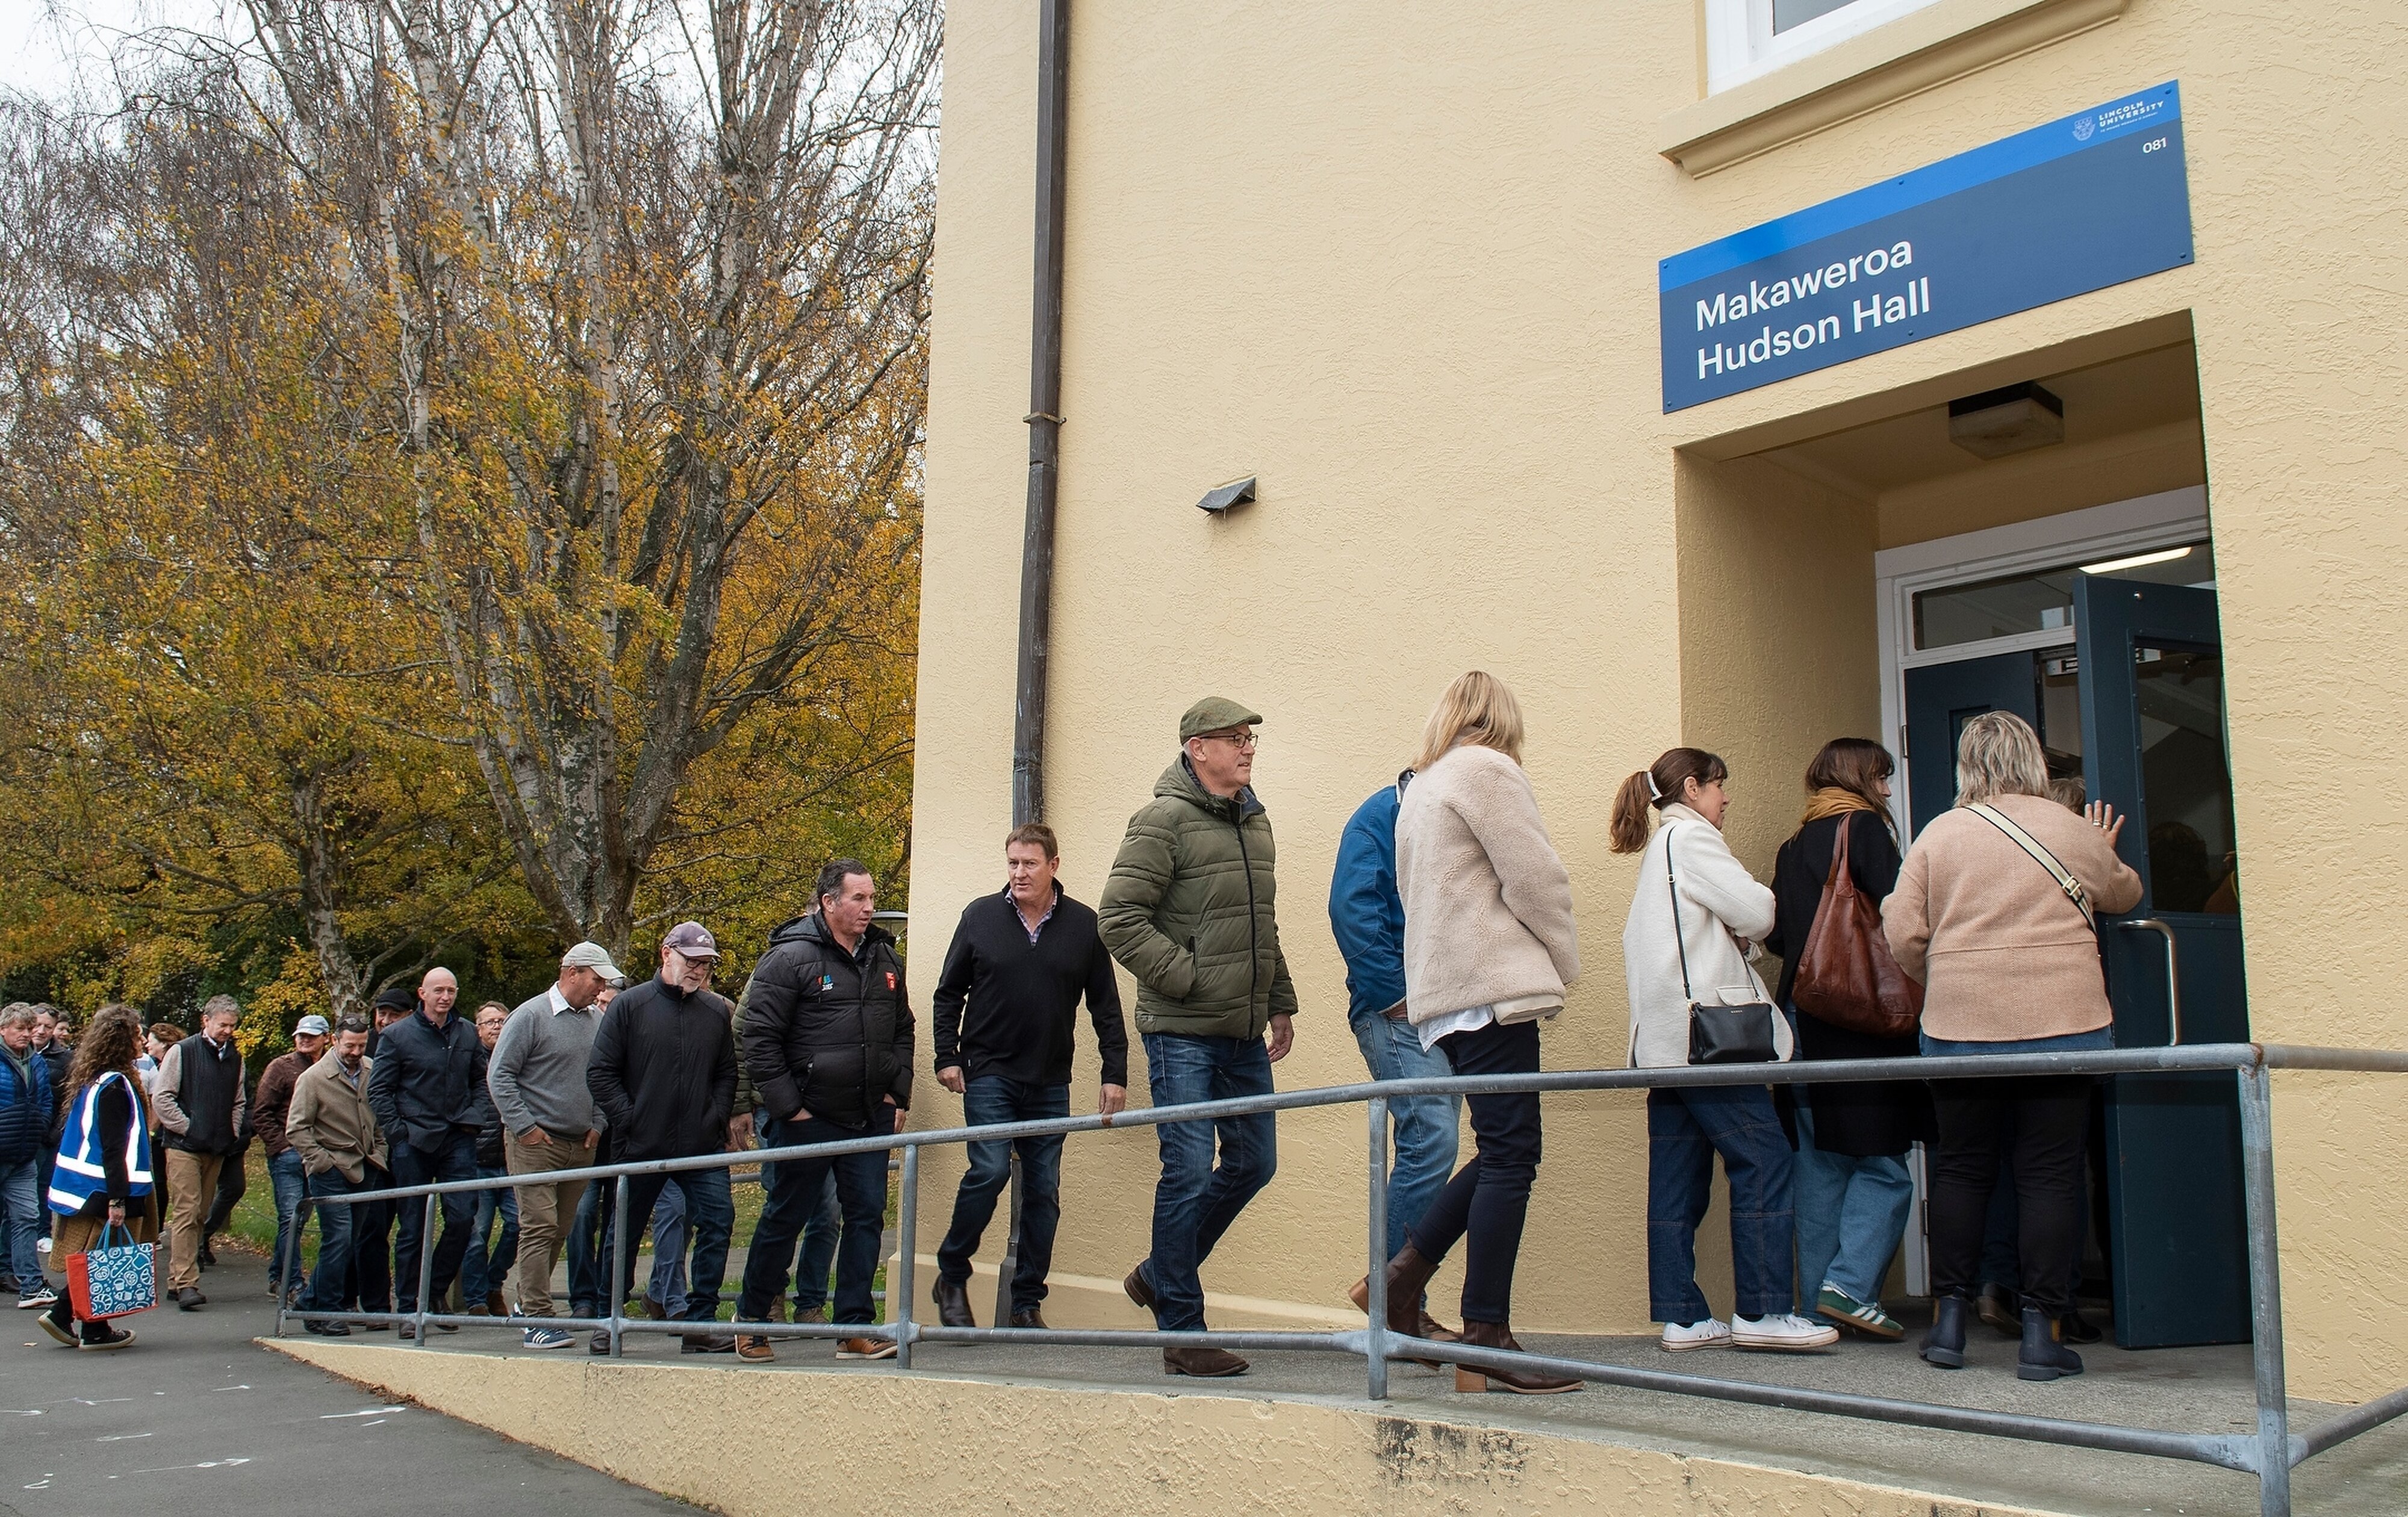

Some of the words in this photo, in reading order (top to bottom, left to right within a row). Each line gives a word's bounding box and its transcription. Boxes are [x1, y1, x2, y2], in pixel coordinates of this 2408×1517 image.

[2098, 101, 2143, 121] LINCOLN
[2100, 101, 2164, 127] UNIVERSITY
[2142, 137, 2167, 154] 081
[1696, 241, 1912, 332] Makaweroa
[1697, 315, 1841, 380] Hudson
[1852, 276, 1930, 333] Hall
